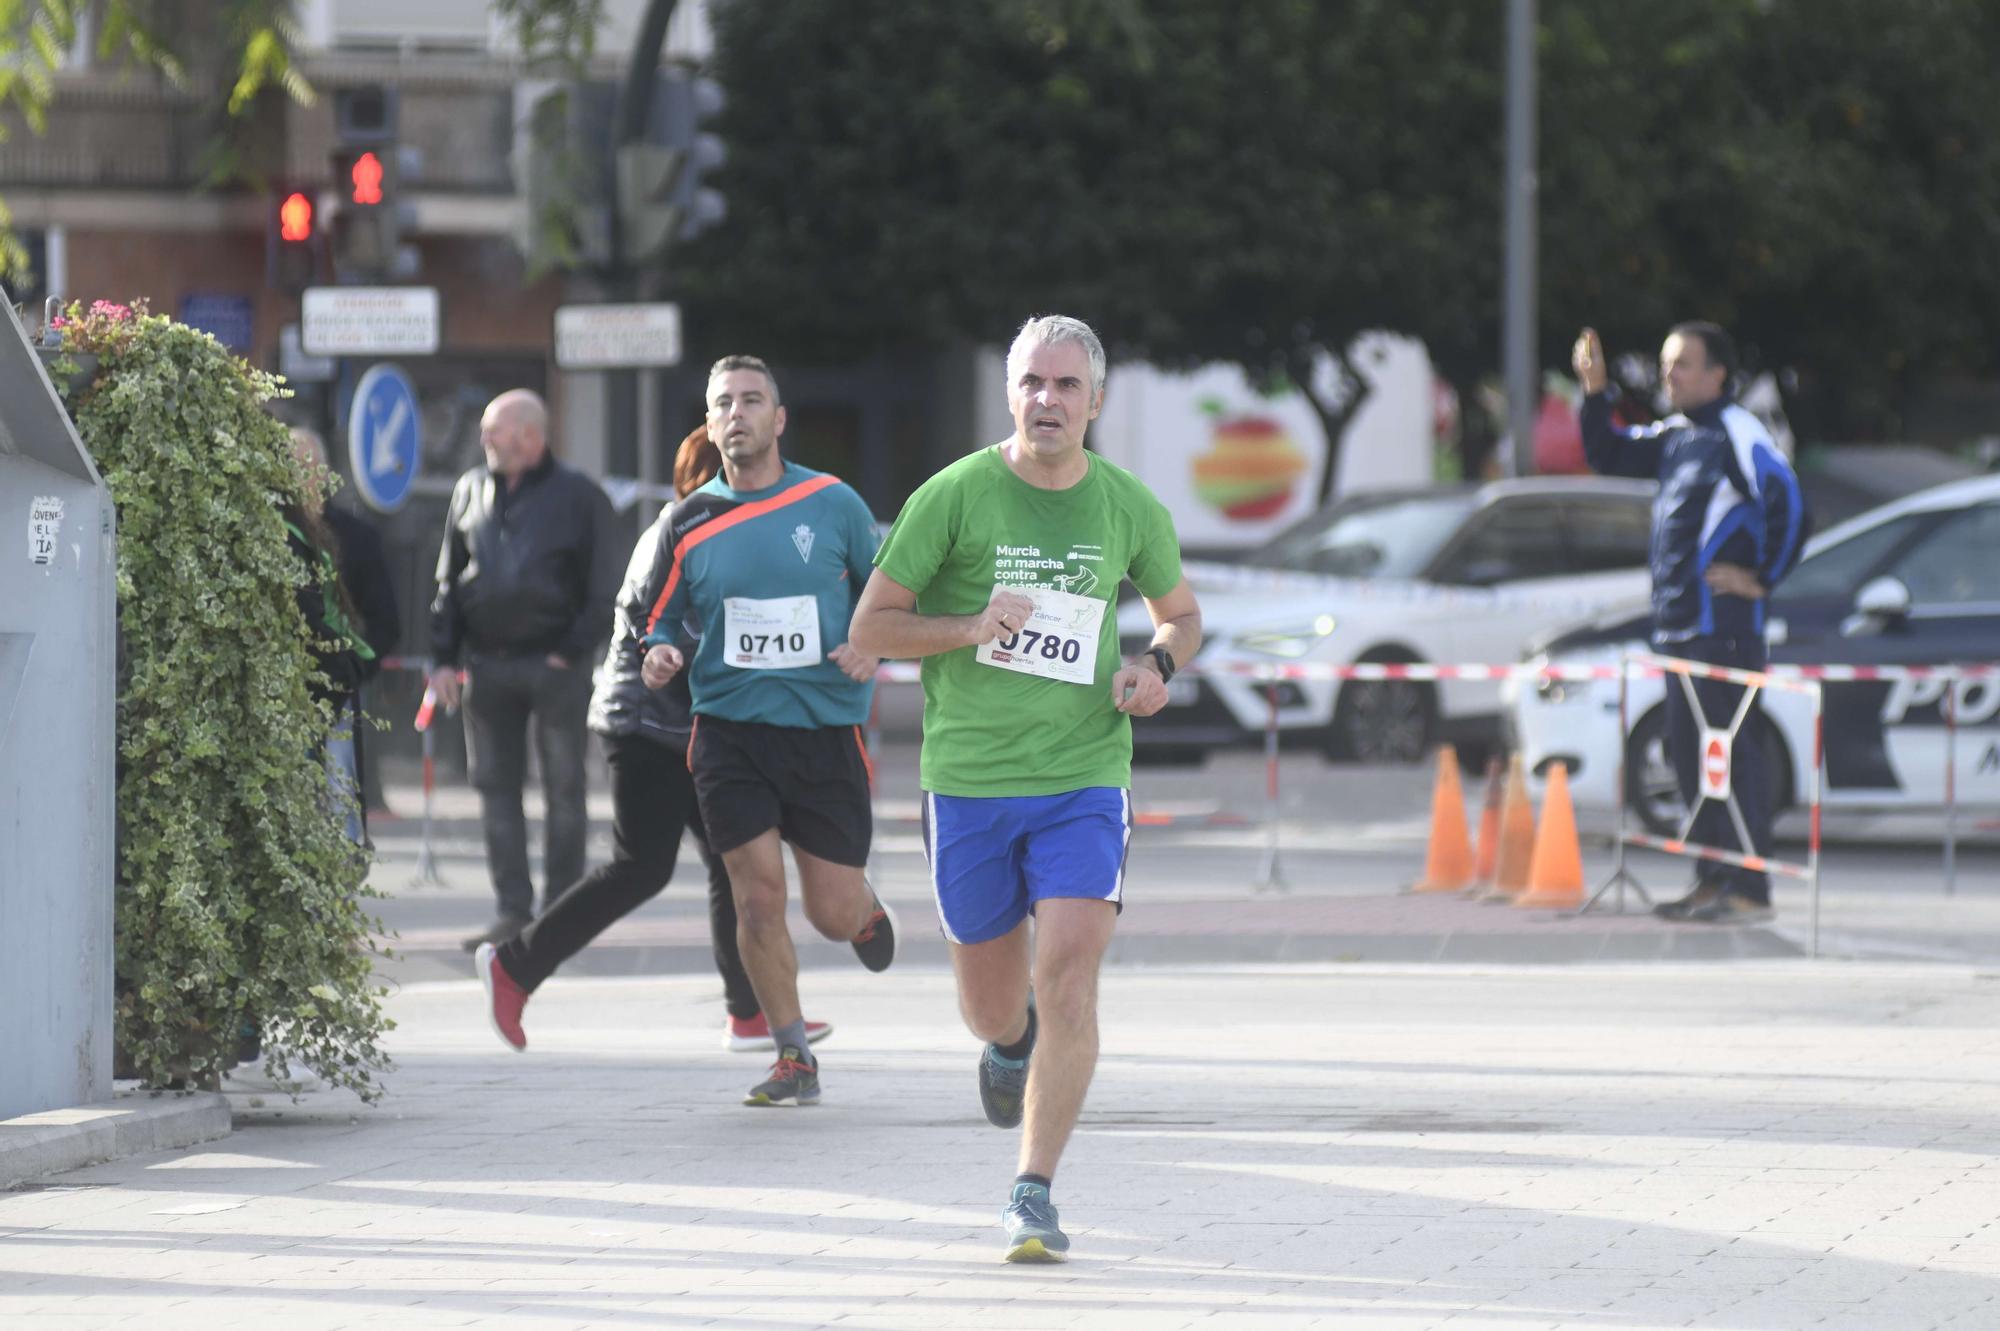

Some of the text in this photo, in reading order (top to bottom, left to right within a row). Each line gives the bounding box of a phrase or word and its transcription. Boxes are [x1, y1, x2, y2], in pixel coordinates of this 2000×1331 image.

[996, 545, 1040, 556] Murcia
[995, 558, 1064, 569] en marcha
[994, 569, 1037, 579] contra
[740, 632, 805, 654] 0710
